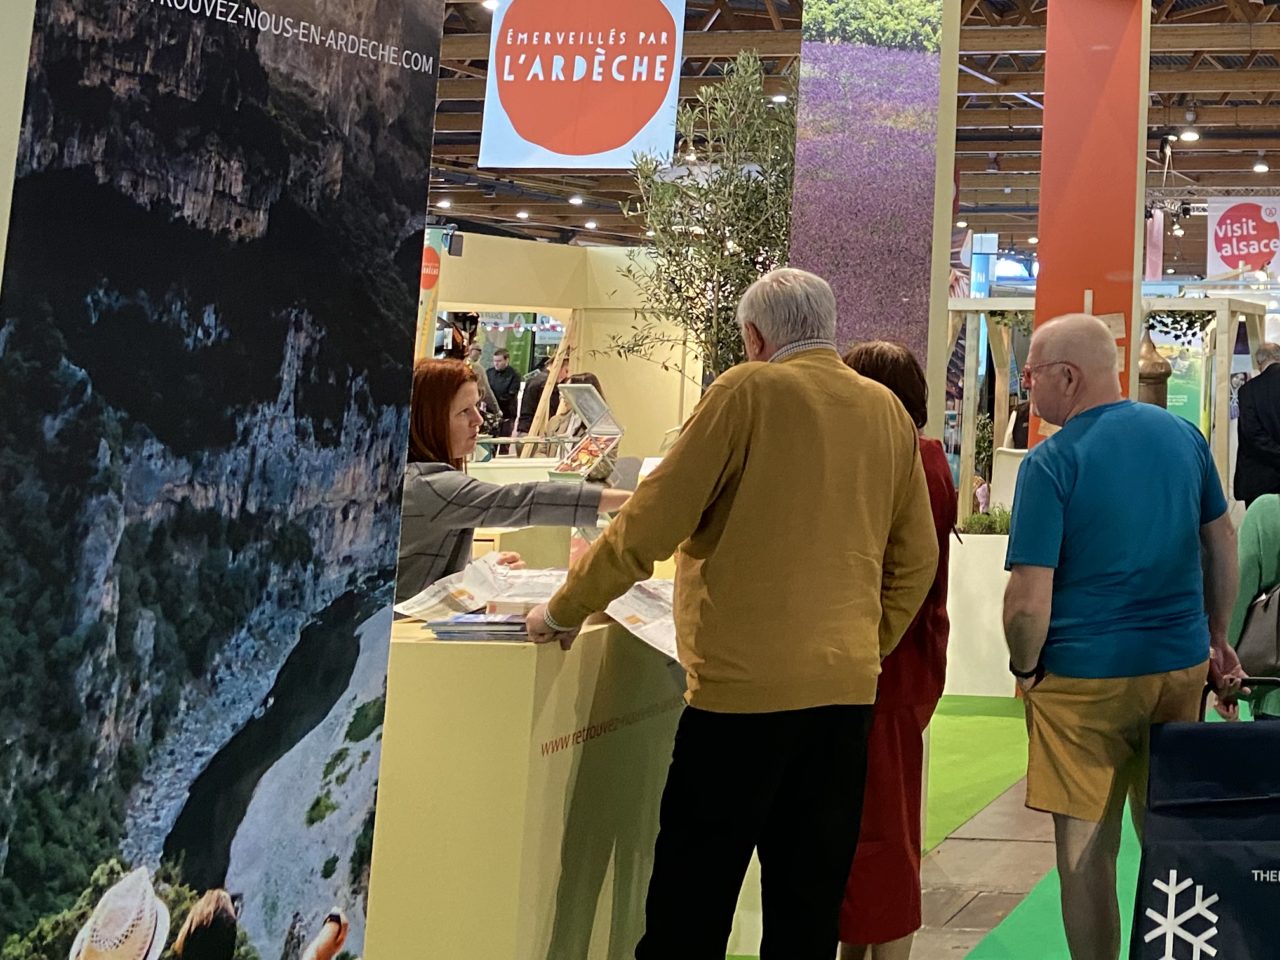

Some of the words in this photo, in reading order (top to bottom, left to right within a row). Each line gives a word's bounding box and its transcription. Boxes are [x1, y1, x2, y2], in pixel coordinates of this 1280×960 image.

[506, 28, 627, 45] ÉMERVEILLÉS
[638, 31, 668, 45] PAR
[503, 47, 667, 82] L'ARDÈCHE
[1215, 217, 1257, 238] visit
